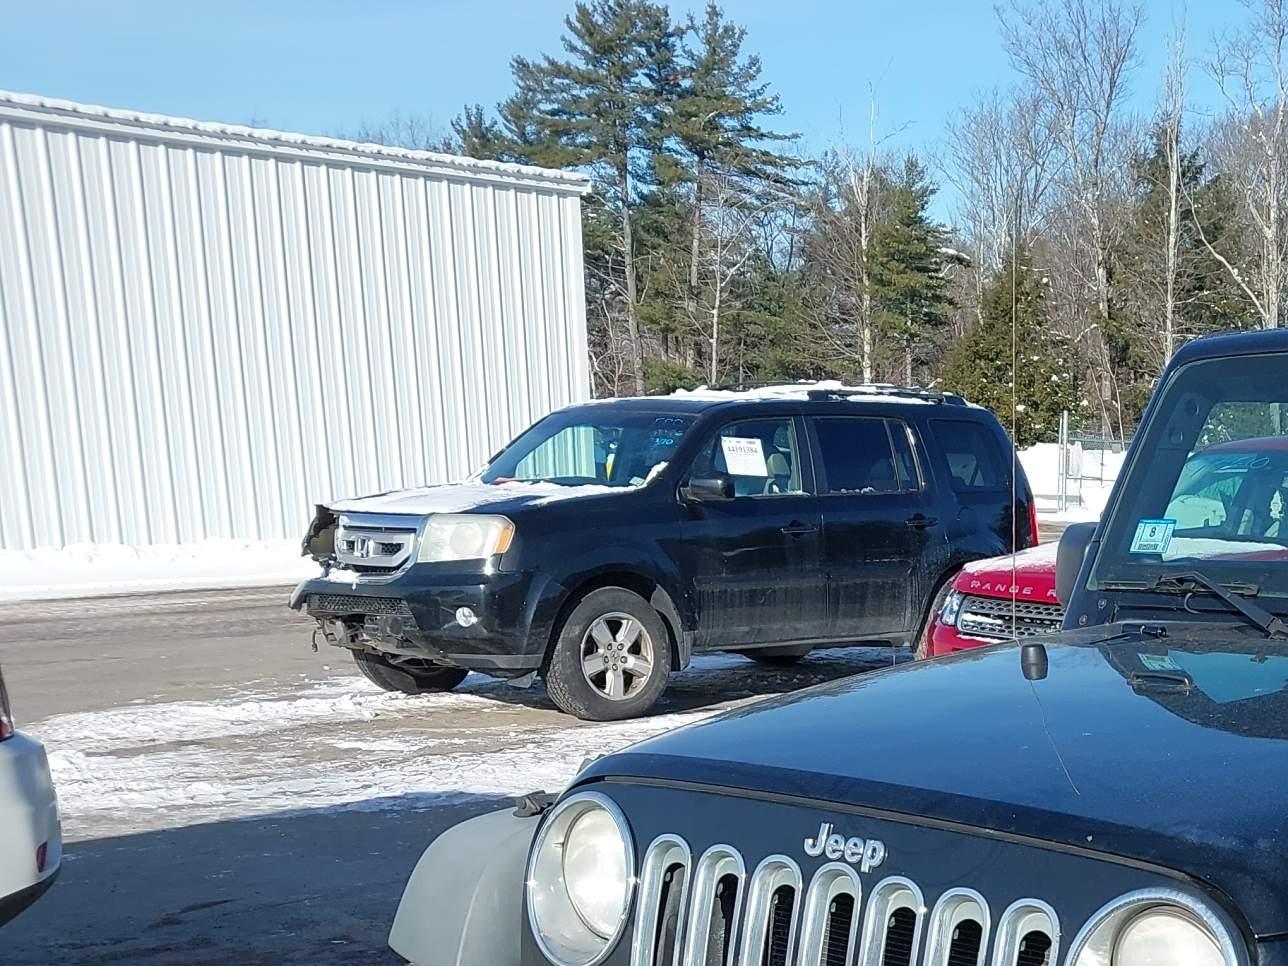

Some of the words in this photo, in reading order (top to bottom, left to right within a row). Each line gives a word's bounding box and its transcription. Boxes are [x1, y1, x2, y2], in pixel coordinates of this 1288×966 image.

[1149, 526, 1157, 537] 8
[970, 580, 1034, 594] RANGE
[803, 822, 887, 873] Jeep
